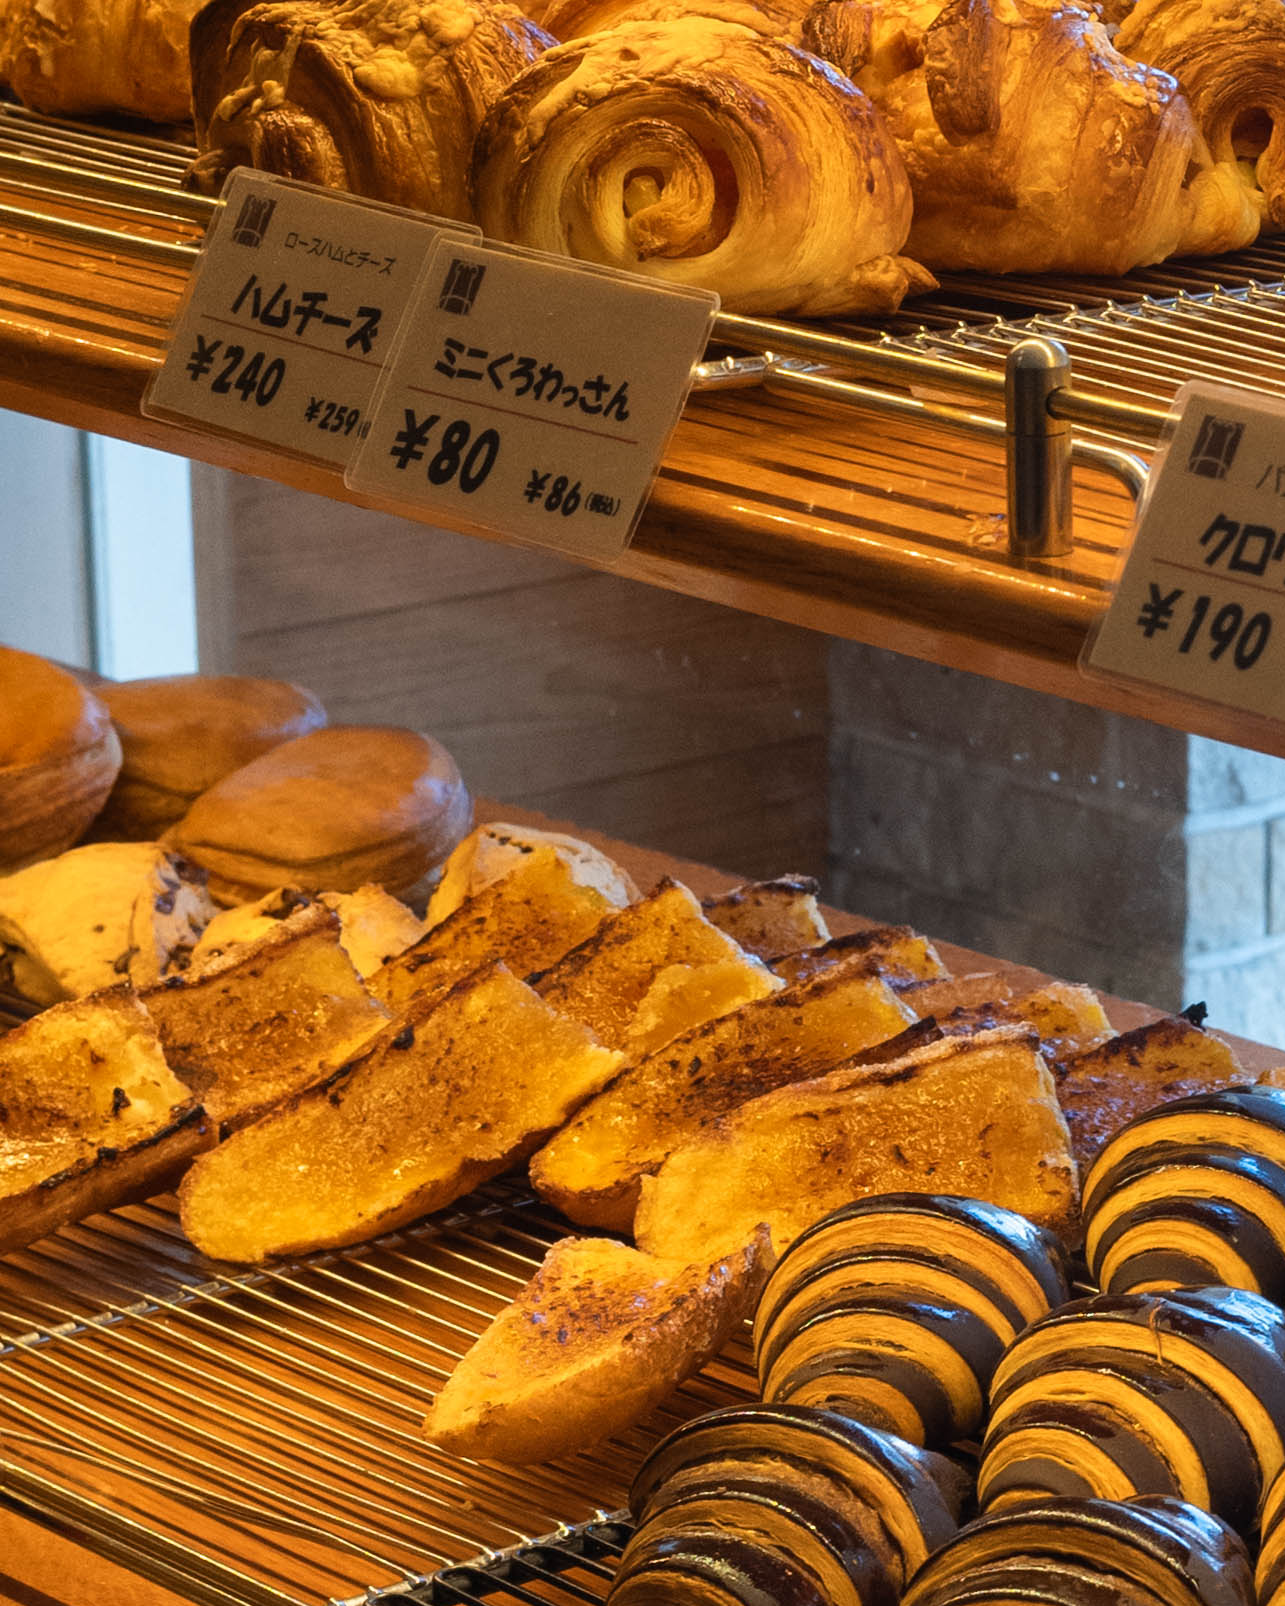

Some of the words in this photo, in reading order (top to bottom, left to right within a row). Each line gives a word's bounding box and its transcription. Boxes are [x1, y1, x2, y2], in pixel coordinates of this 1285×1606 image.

[231, 274, 383, 353] ハムチーズ
[185, 334, 286, 407] ¥240
[435, 337, 630, 422] ミニくろわっさん
[390, 408, 500, 494] ¥80
[1137, 583, 1272, 671] ¥190
